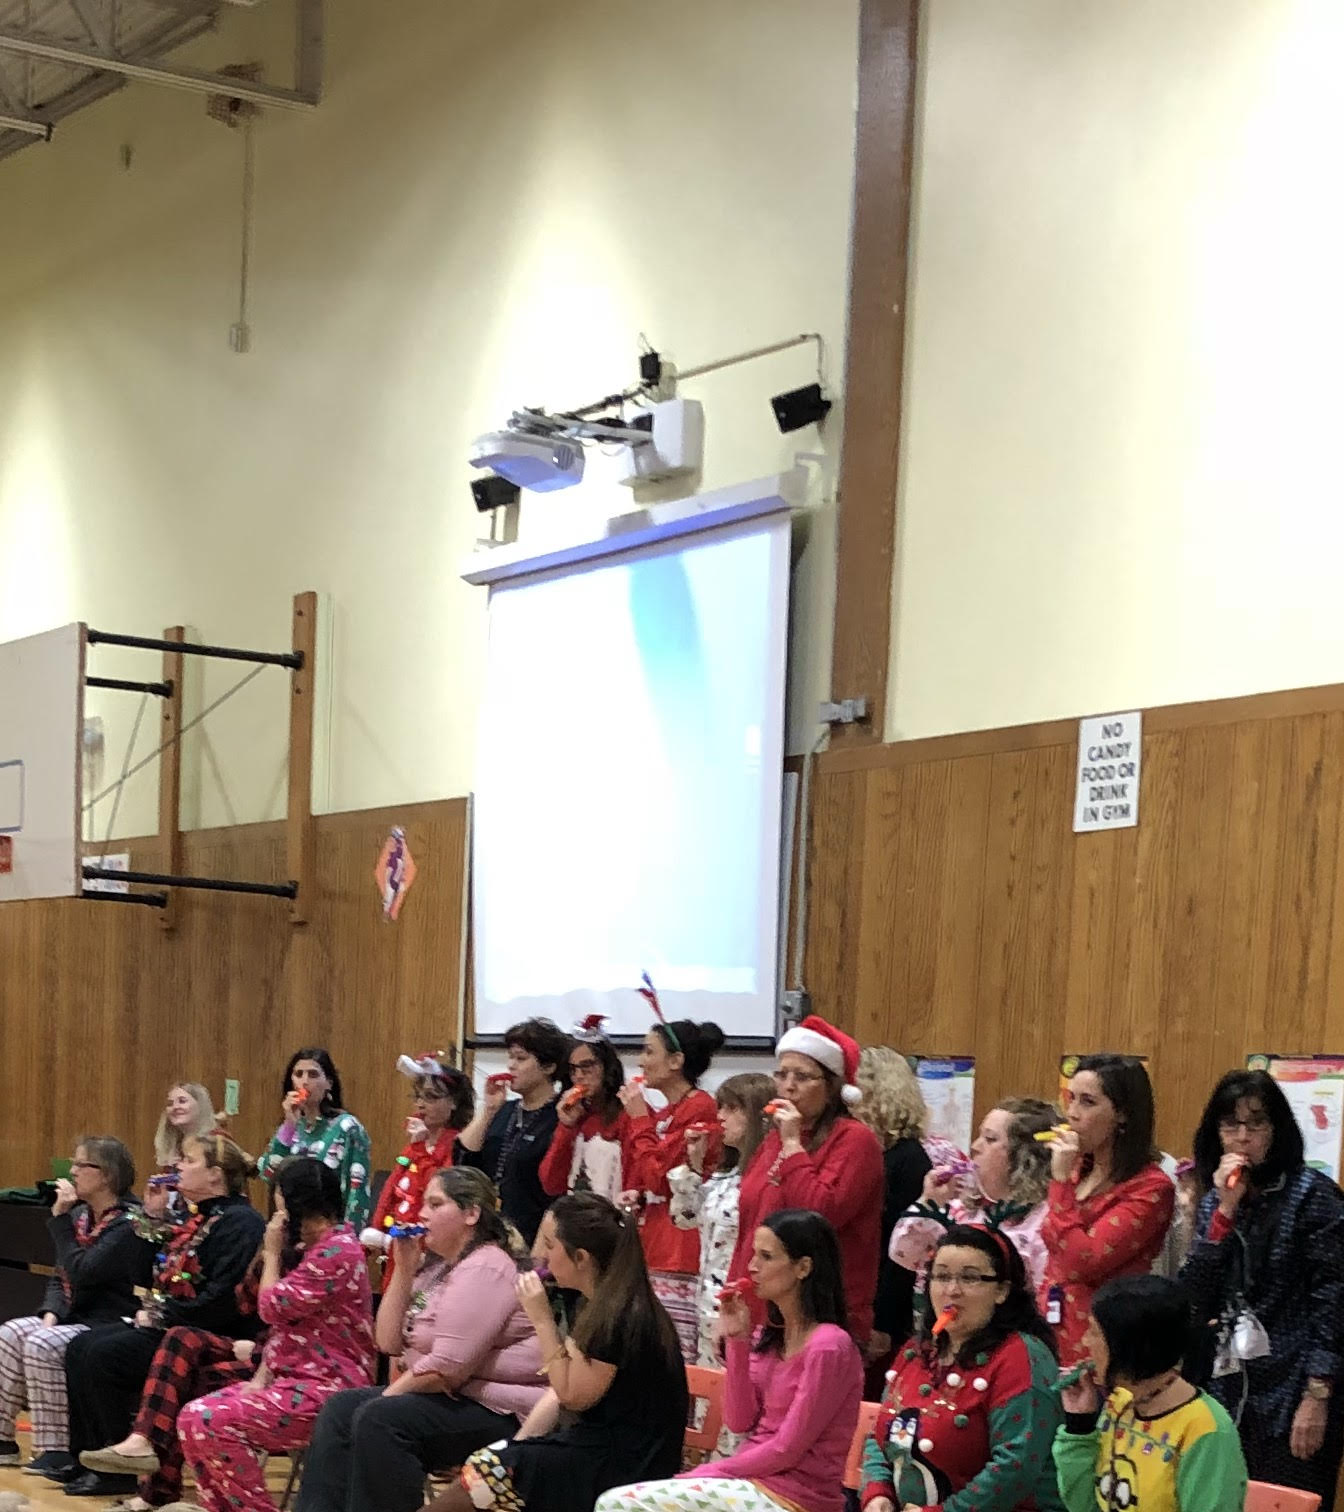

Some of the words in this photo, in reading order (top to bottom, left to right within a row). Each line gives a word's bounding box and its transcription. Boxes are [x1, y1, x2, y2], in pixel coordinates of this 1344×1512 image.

[1102, 722, 1124, 740] NO
[1087, 742, 1132, 762] CANDY
[1081, 765, 1116, 783] FOOD
[1118, 762, 1136, 779] OR
[1089, 783, 1129, 802] DRINK
[1083, 806, 1100, 823] IN
[1102, 803, 1131, 820] GYM
